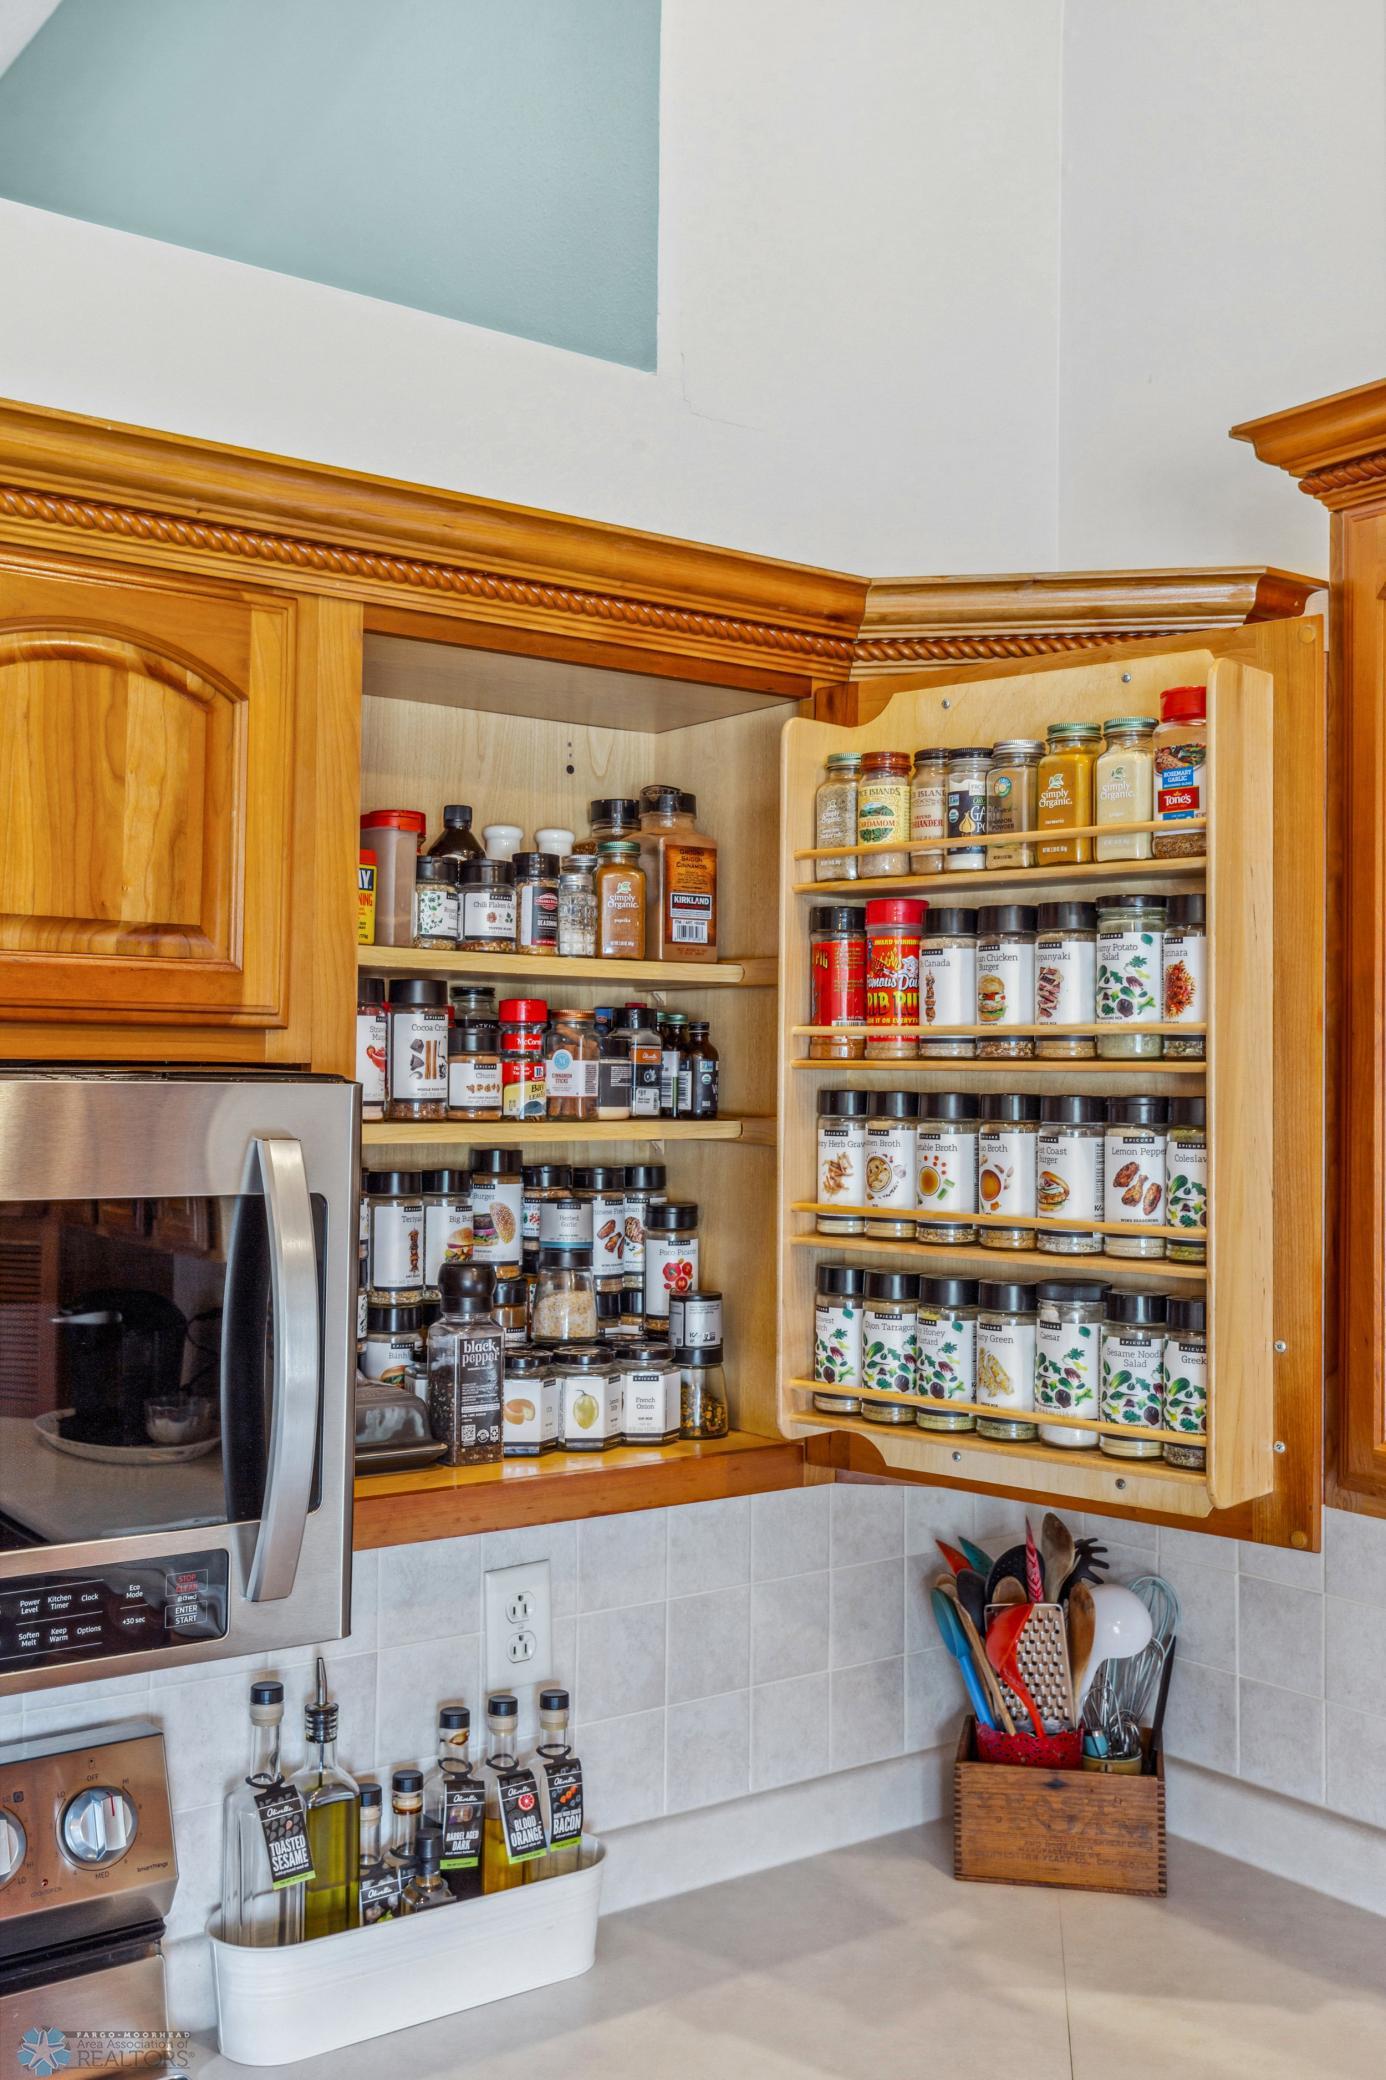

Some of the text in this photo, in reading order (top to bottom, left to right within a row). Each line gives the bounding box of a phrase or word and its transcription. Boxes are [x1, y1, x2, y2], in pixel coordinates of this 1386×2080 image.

[1163, 769, 1191, 778] ROSEMARY
[1041, 788, 1069, 801] Simply
[1164, 794, 1192, 807] Tone's
[609, 894, 636, 903] Simply
[673, 895, 710, 905] KIRKLAND
[1113, 943, 1138, 952] Potato
[924, 958, 951, 967] Canada
[986, 953, 1018, 962] Chicken
[411, 1024, 433, 1032] Cocoa
[828, 1139, 845, 1148] Herb
[879, 1139, 901, 1148] Broth
[934, 1143, 958, 1152] Broth
[987, 1144, 1008, 1153] Broth
[1046, 1146, 1068, 1156] Coast
[1111, 1146, 1138, 1156] Lemon
[449, 1215, 461, 1224] Big
[922, 1328, 946, 1339] Honey
[1040, 1332, 1061, 1342] Caesar
[989, 1334, 1014, 1345] Green
[463, 1338, 496, 1354] black
[1106, 1347, 1135, 1359] Sesame
[462, 1351, 500, 1368] pepper
[1123, 1359, 1148, 1368] Salad
[1181, 1357, 1207, 1367] Greek
[178, 1573, 197, 1583] STOP
[129, 1584, 140, 1592] Eco
[47, 1594, 72, 1604] Kitchen
[81, 1593, 99, 1602] Clock
[126, 1590, 143, 1599] Mode
[20, 1598, 40, 1608] Power
[51, 1601, 69, 1610] Timer
[21, 1606, 38, 1614] Level
[175, 1605, 198, 1615] ENTER
[122, 1617, 134, 1625] +30
[175, 1615, 198, 1625] START
[51, 1627, 67, 1637] Keep
[76, 1624, 102, 1635] Options
[18, 1631, 40, 1641] Soften
[49, 1634, 68, 1643] Warm
[21, 1639, 37, 1648] Melt
[87, 1773, 98, 1782] OFF
[513, 1815, 537, 1832] BLOOD
[553, 1814, 581, 1835] BACON
[446, 1830, 480, 1842] BARREL AGED
[510, 1825, 544, 1848] ORANGE
[268, 1834, 306, 1857] TOASTED
[451, 1840, 471, 1851] DARK
[271, 1848, 309, 1872] SESAME
[95, 1871, 110, 1879] MED
